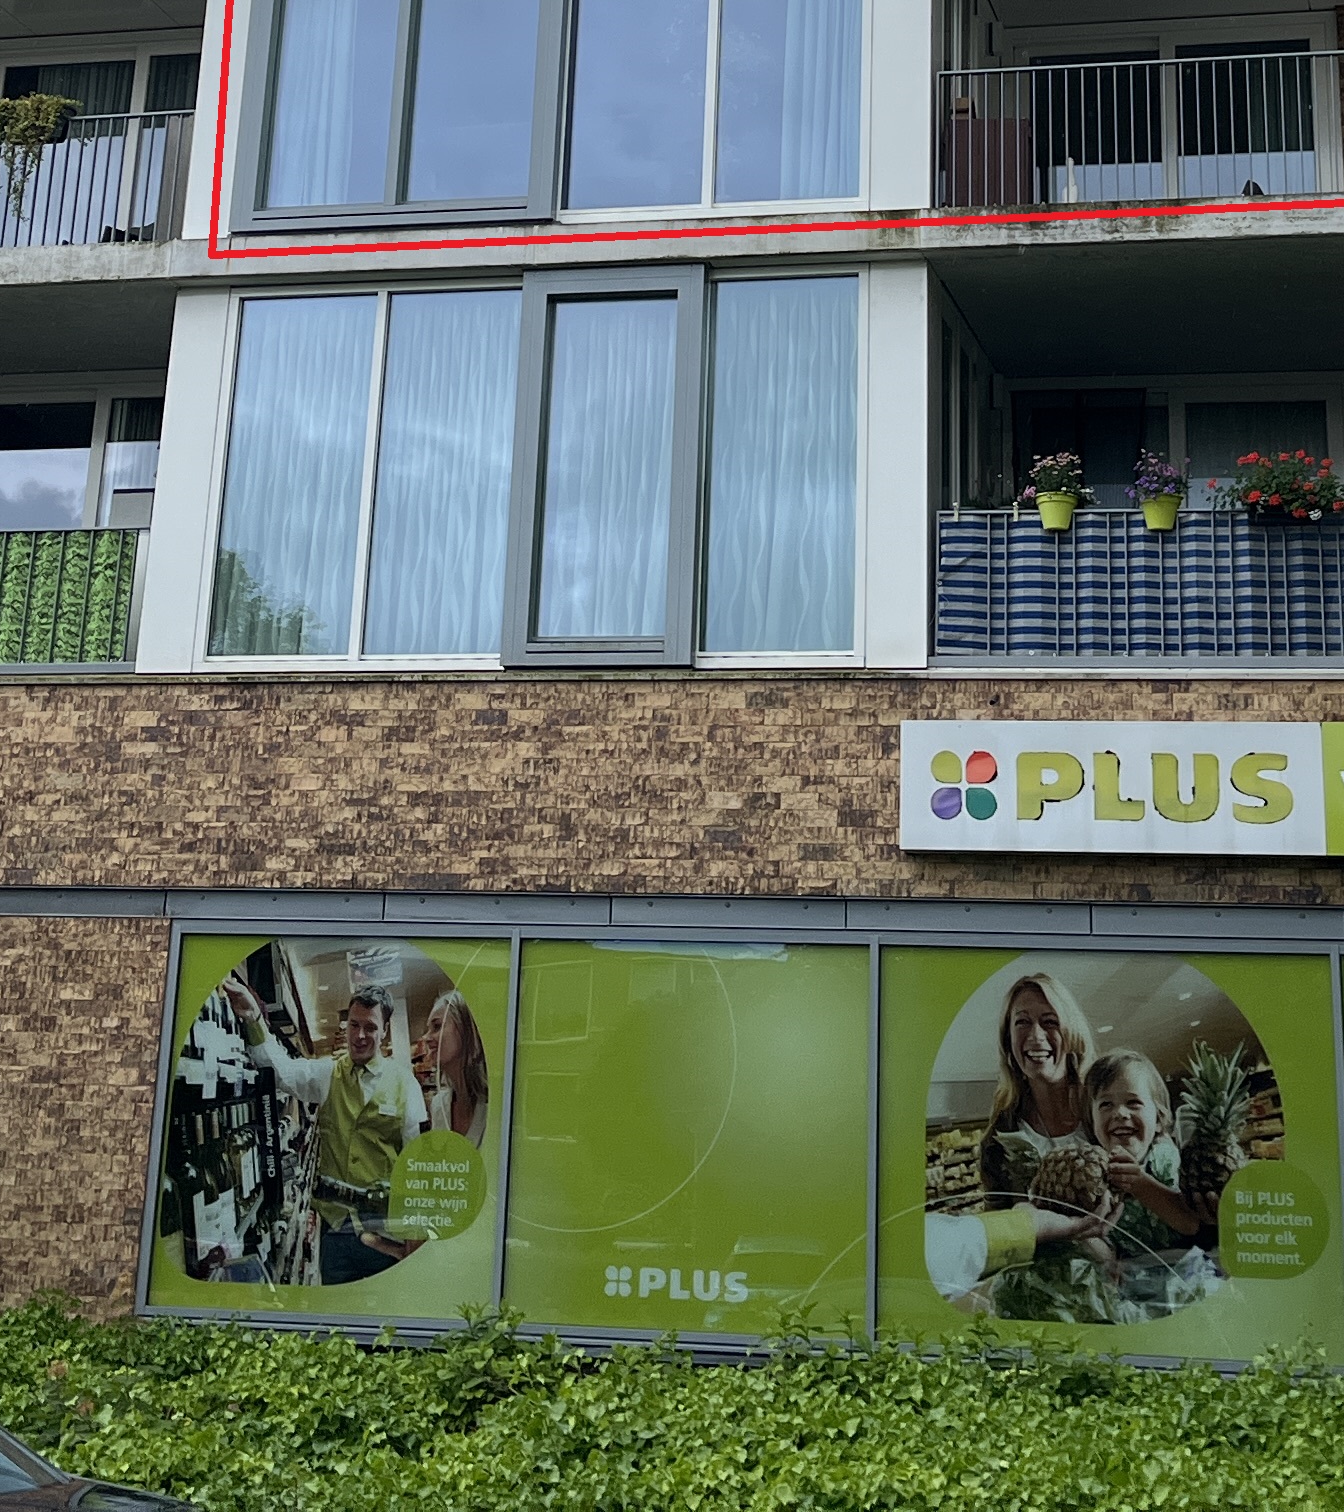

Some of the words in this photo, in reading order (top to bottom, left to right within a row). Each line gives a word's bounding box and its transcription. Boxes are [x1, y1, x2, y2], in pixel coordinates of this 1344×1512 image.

[1016, 750, 1294, 824] PLUS
[407, 1158, 470, 1174] Smaakvol
[405, 1178, 429, 1190] van
[404, 1197, 435, 1208] onze
[439, 1195, 468, 1213] wijn
[1235, 1190, 1253, 1208] Bij
[1257, 1191, 1295, 1207] PLUS
[402, 1211, 455, 1227] selectie.
[1235, 1210, 1313, 1228] producten
[1236, 1232, 1271, 1244] voor
[1275, 1230, 1298, 1246] elk
[1236, 1251, 1306, 1266] moment.
[638, 1266, 749, 1303] PLUS
